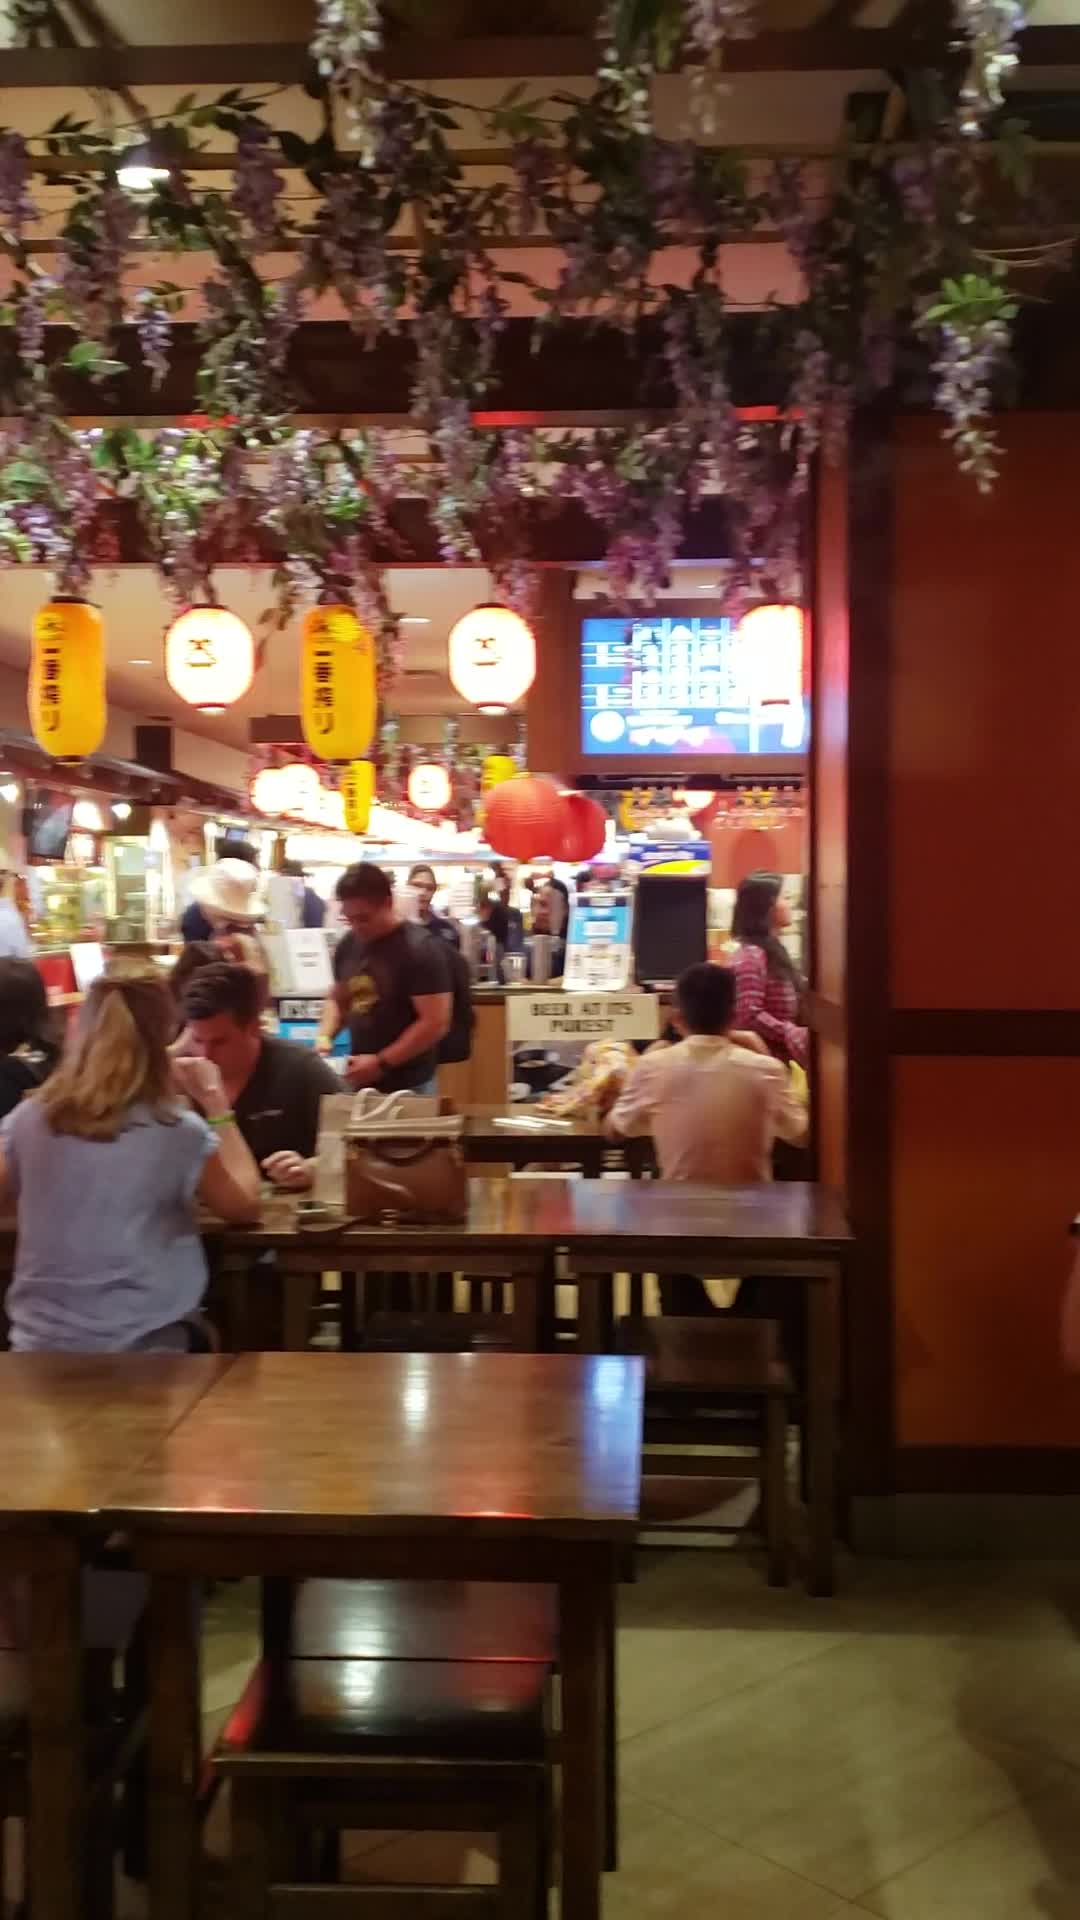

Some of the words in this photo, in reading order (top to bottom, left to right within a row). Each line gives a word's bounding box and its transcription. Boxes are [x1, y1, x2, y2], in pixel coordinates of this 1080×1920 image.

[532, 1003, 571, 1016] BEER
[581, 1002, 601, 1015] AT
[607, 1002, 634, 1015] ITS
[551, 1019, 615, 1032] PUREST
